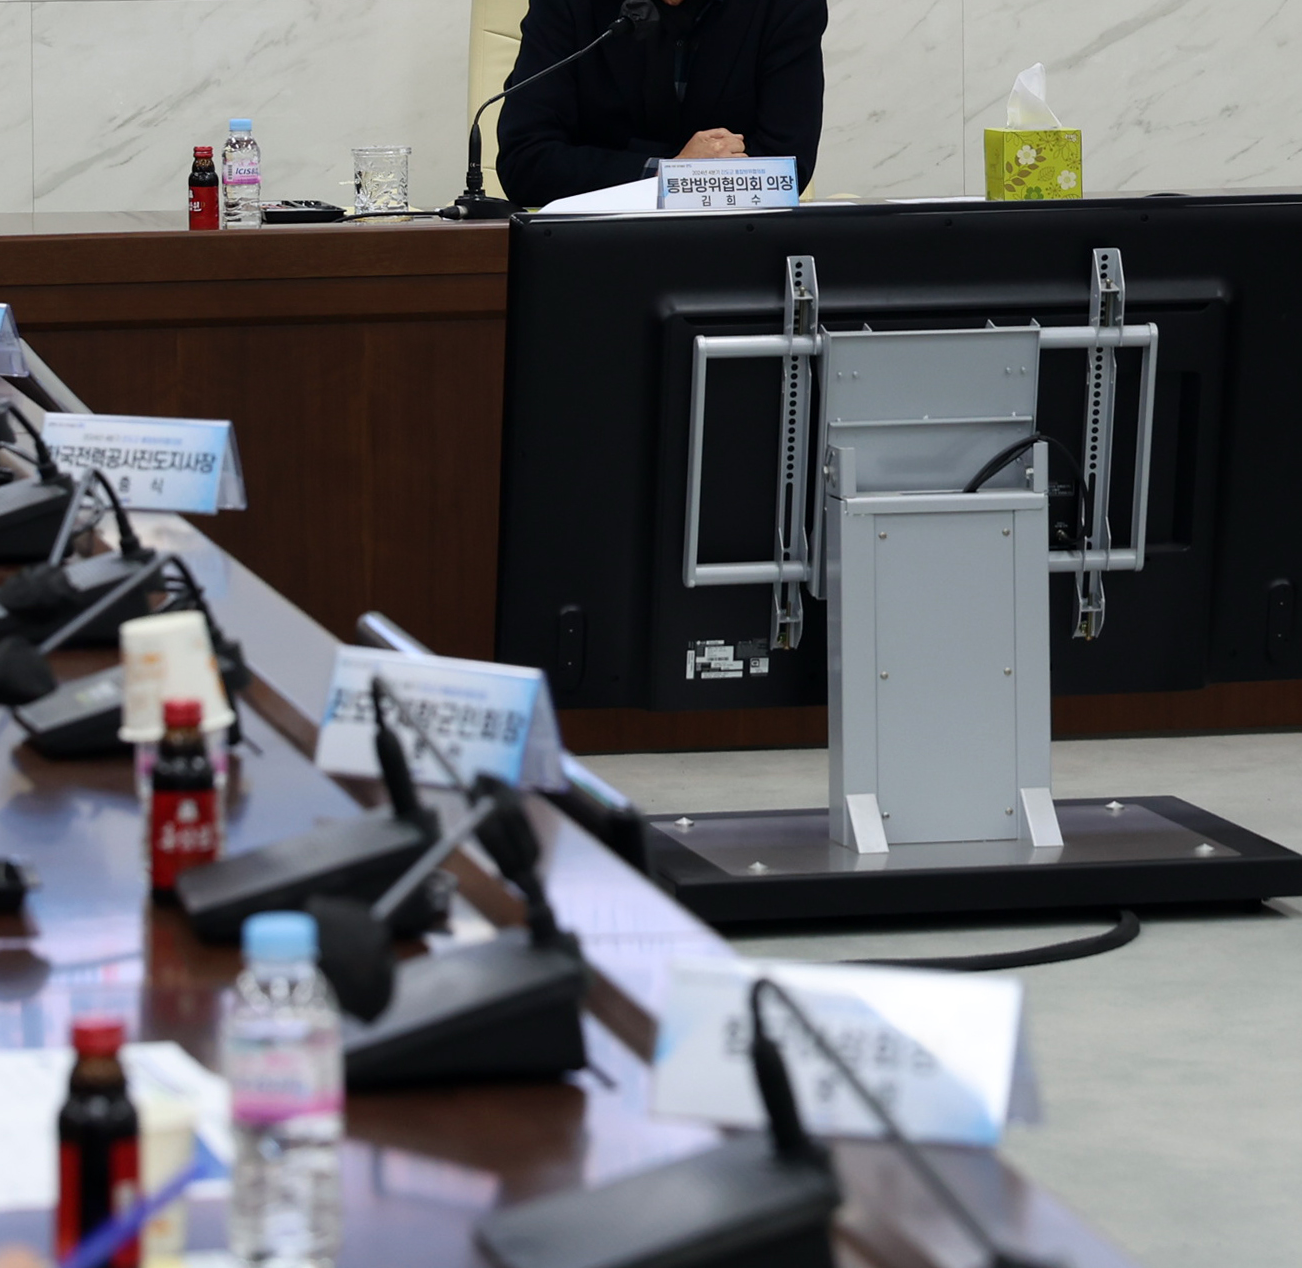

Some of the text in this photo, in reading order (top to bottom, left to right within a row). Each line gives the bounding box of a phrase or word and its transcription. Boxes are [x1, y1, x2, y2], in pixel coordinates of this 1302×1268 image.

[666, 175, 795, 194] 통합방위협의회 의장
[701, 194, 762, 207] 김 희 수
